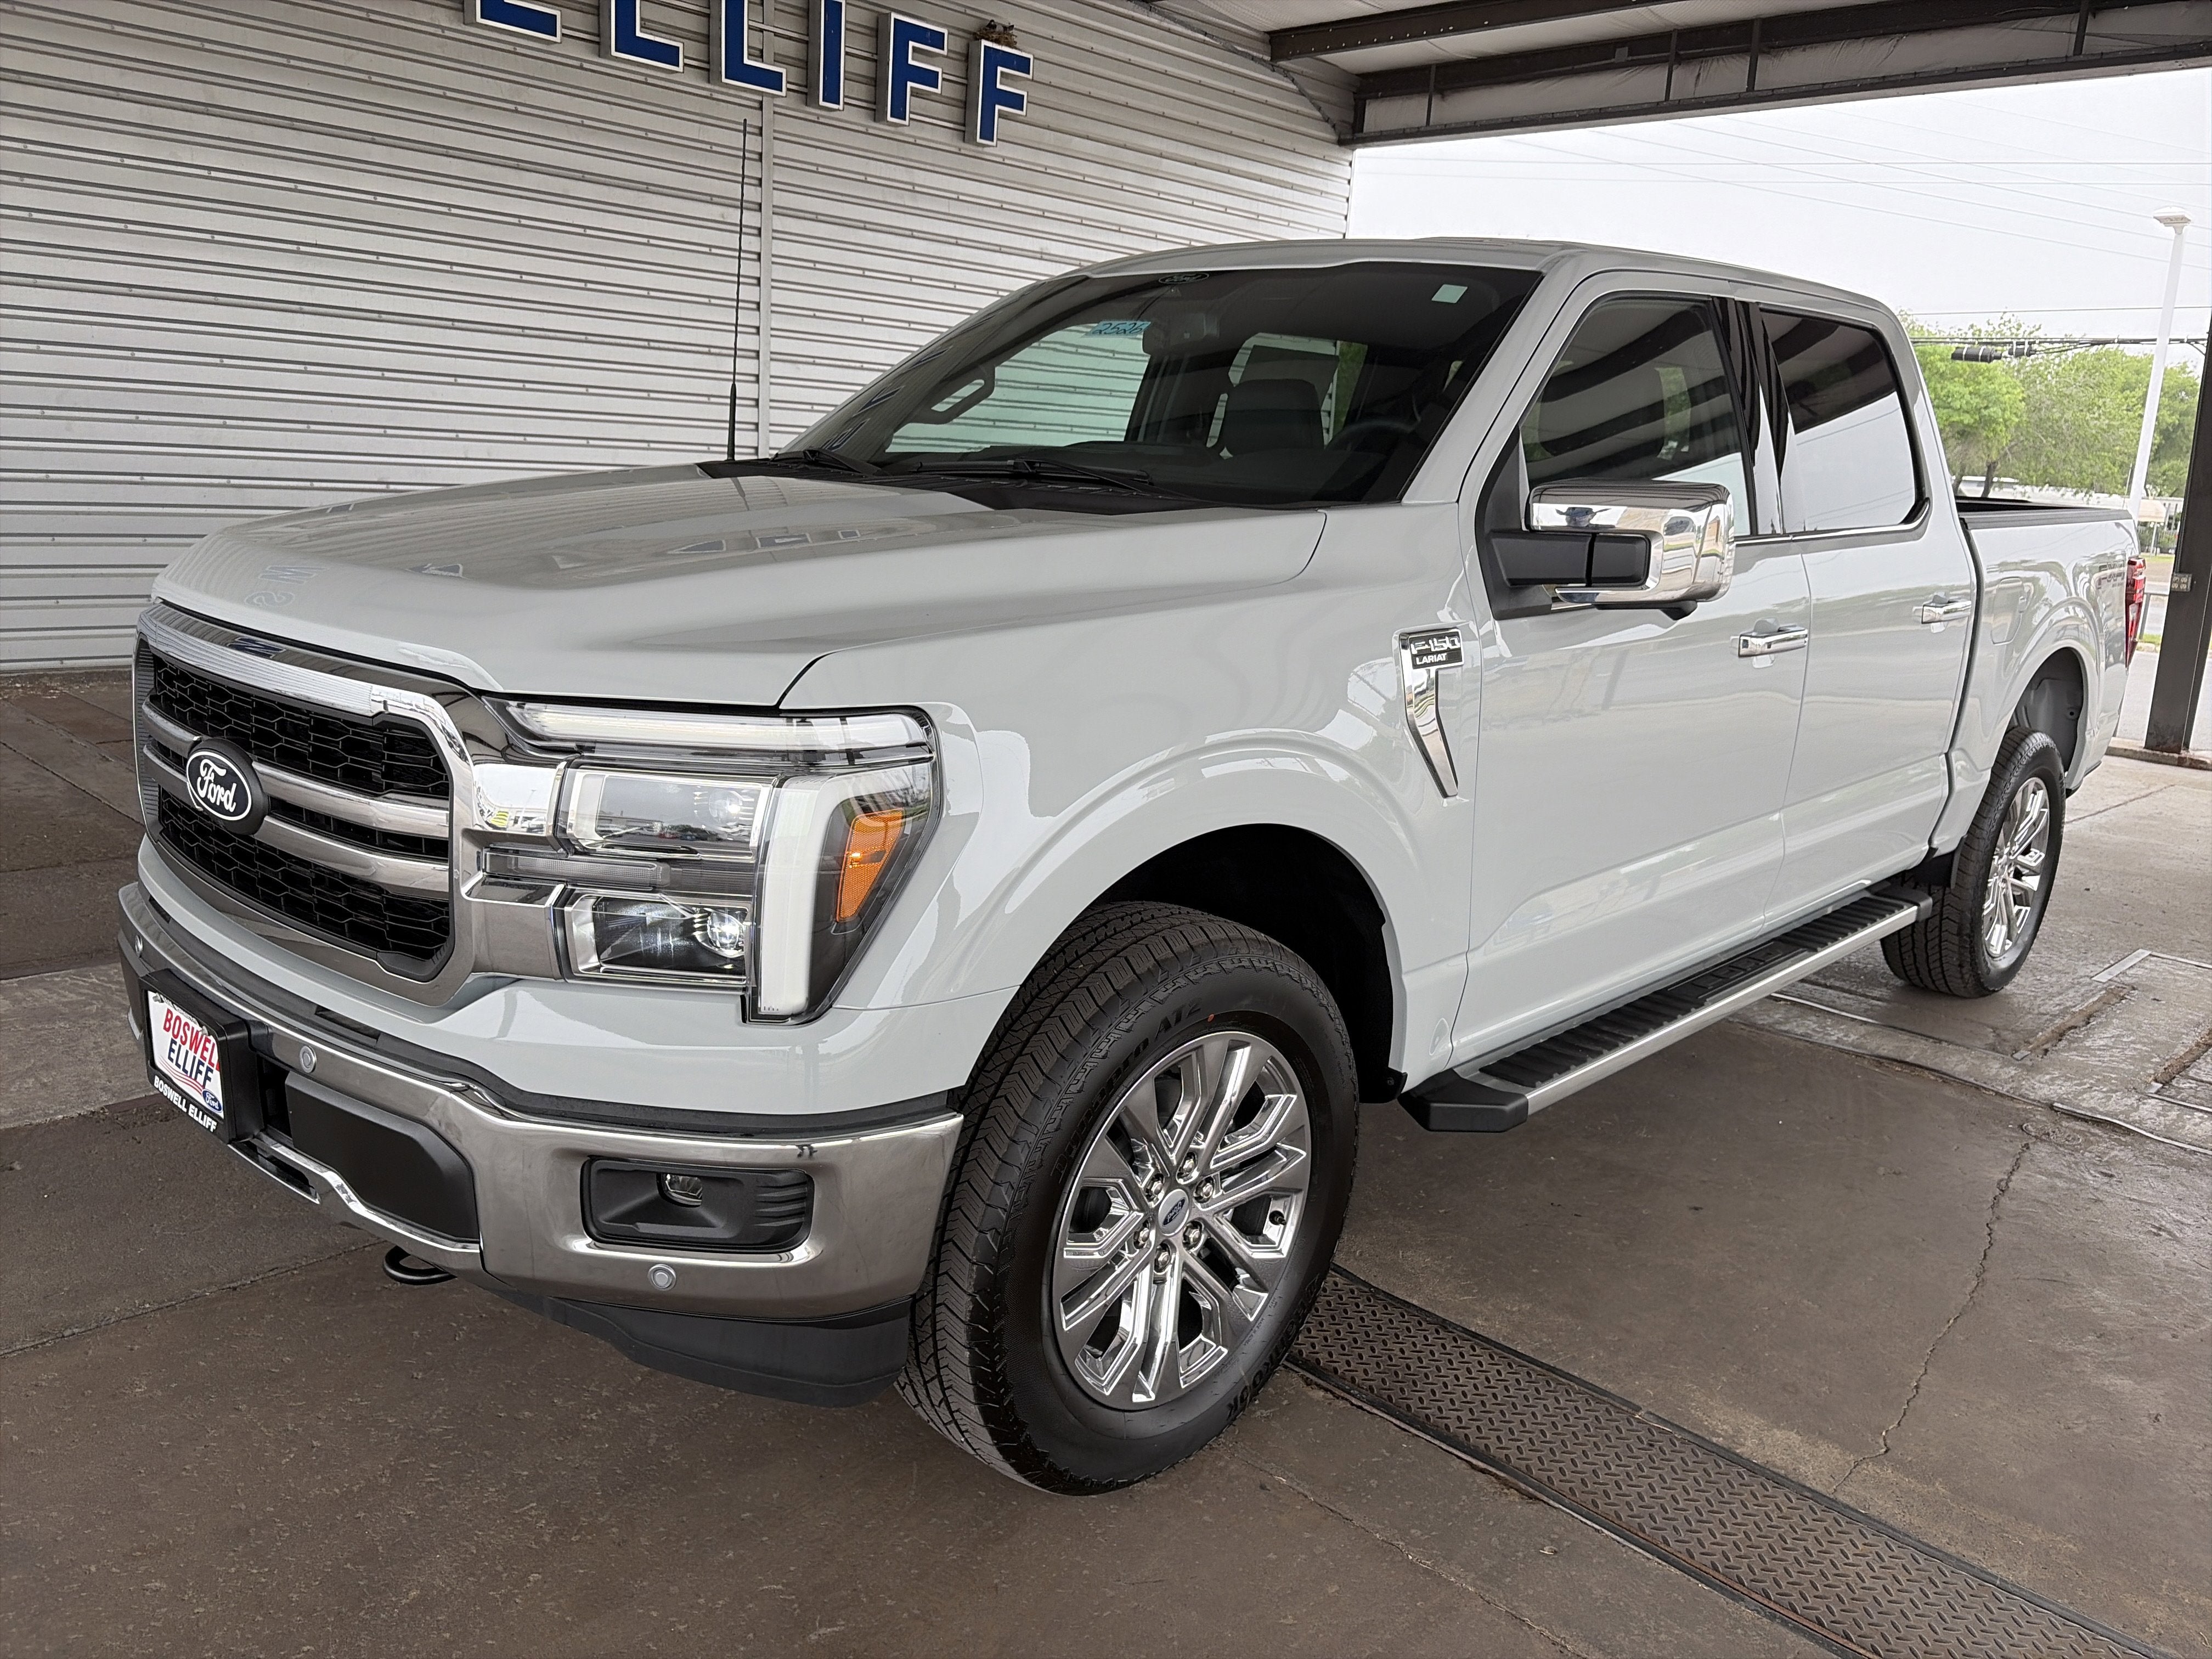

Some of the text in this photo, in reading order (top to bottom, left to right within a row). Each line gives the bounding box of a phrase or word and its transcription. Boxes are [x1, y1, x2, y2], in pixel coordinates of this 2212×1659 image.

[1410, 636, 1461, 654] F-150
[1416, 653, 1447, 665] LARIAT
[197, 759, 237, 812] Ford
[163, 1008, 220, 1072] BOSWEL
[167, 1037, 213, 1090] ELLIFF
[154, 1075, 218, 1133] BOSWELL ELLIFF
[204, 1091, 219, 1110] Ford
